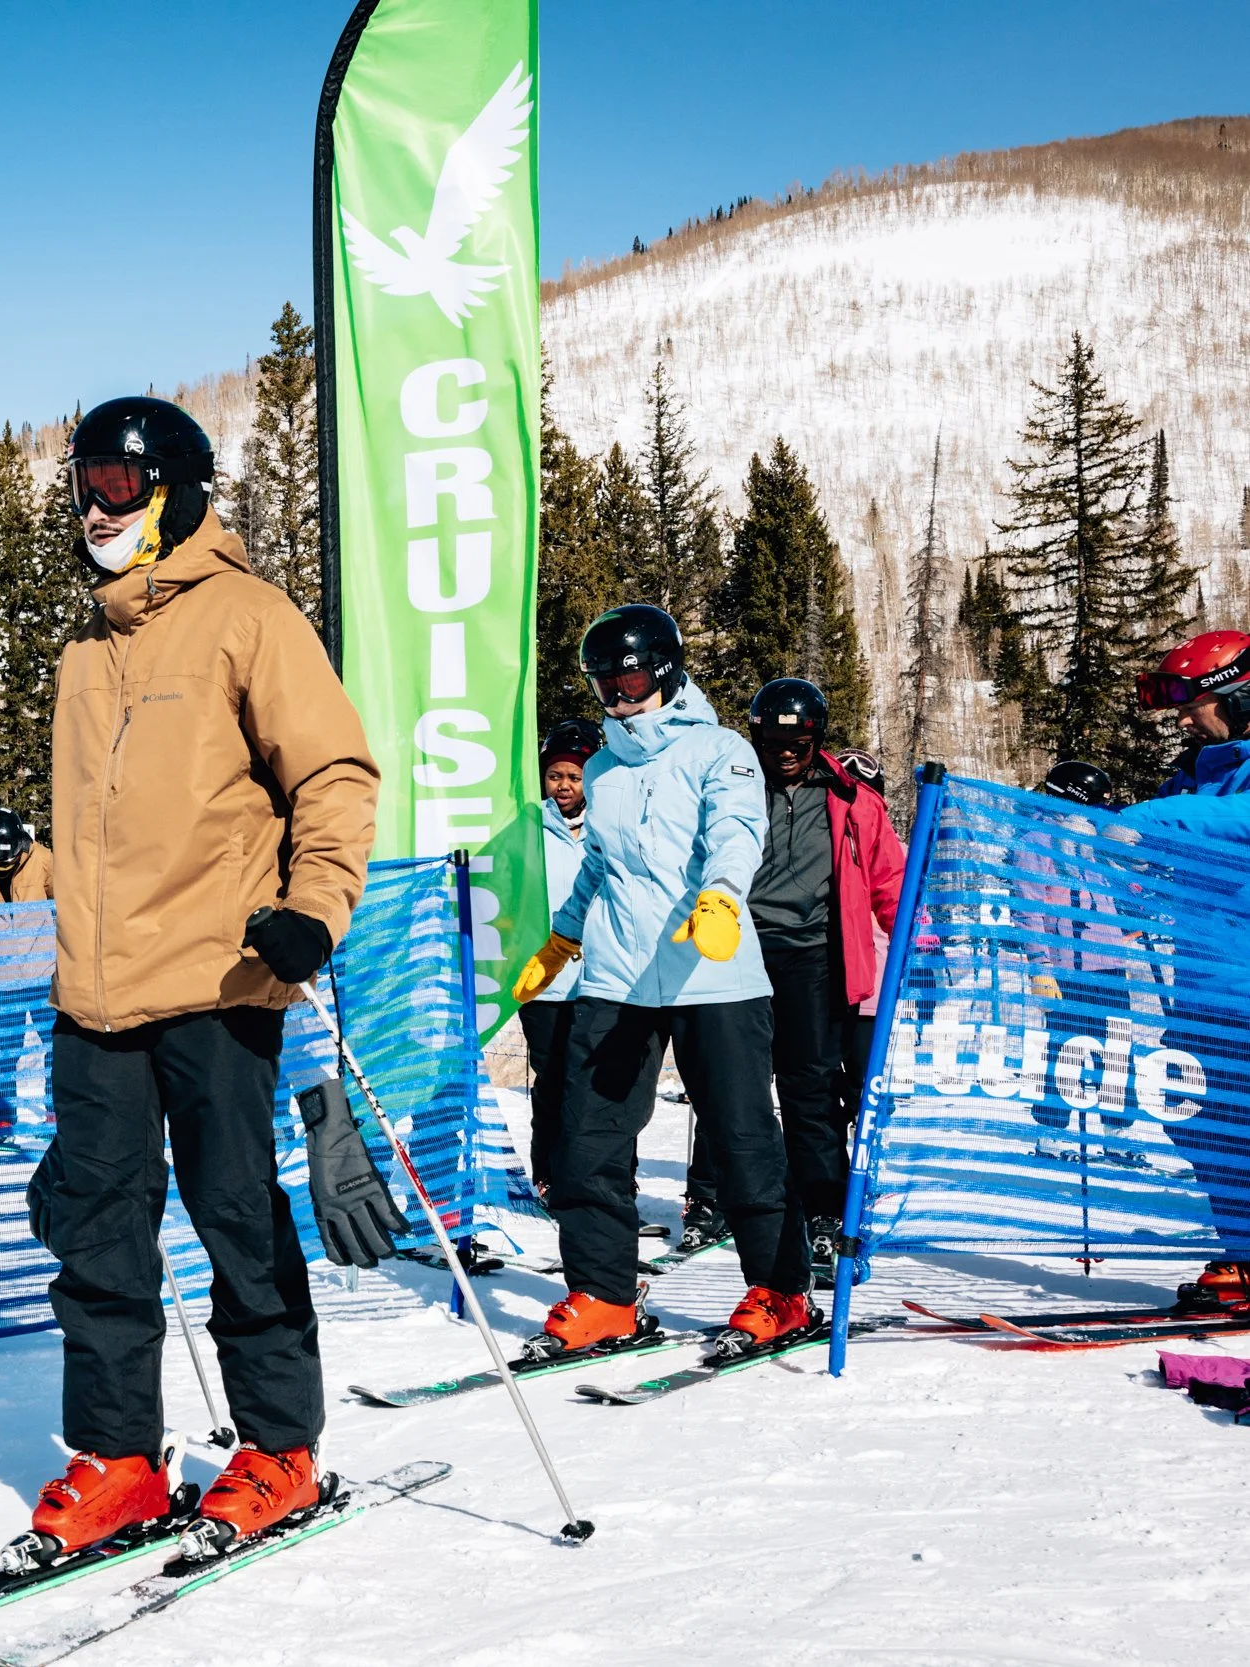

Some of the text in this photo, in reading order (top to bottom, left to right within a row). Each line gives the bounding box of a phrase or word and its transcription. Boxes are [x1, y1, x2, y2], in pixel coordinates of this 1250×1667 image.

[1200, 666, 1240, 688] SMITH
[149, 692, 183, 702] Columbia
[1066, 785, 1089, 802] SMITH
